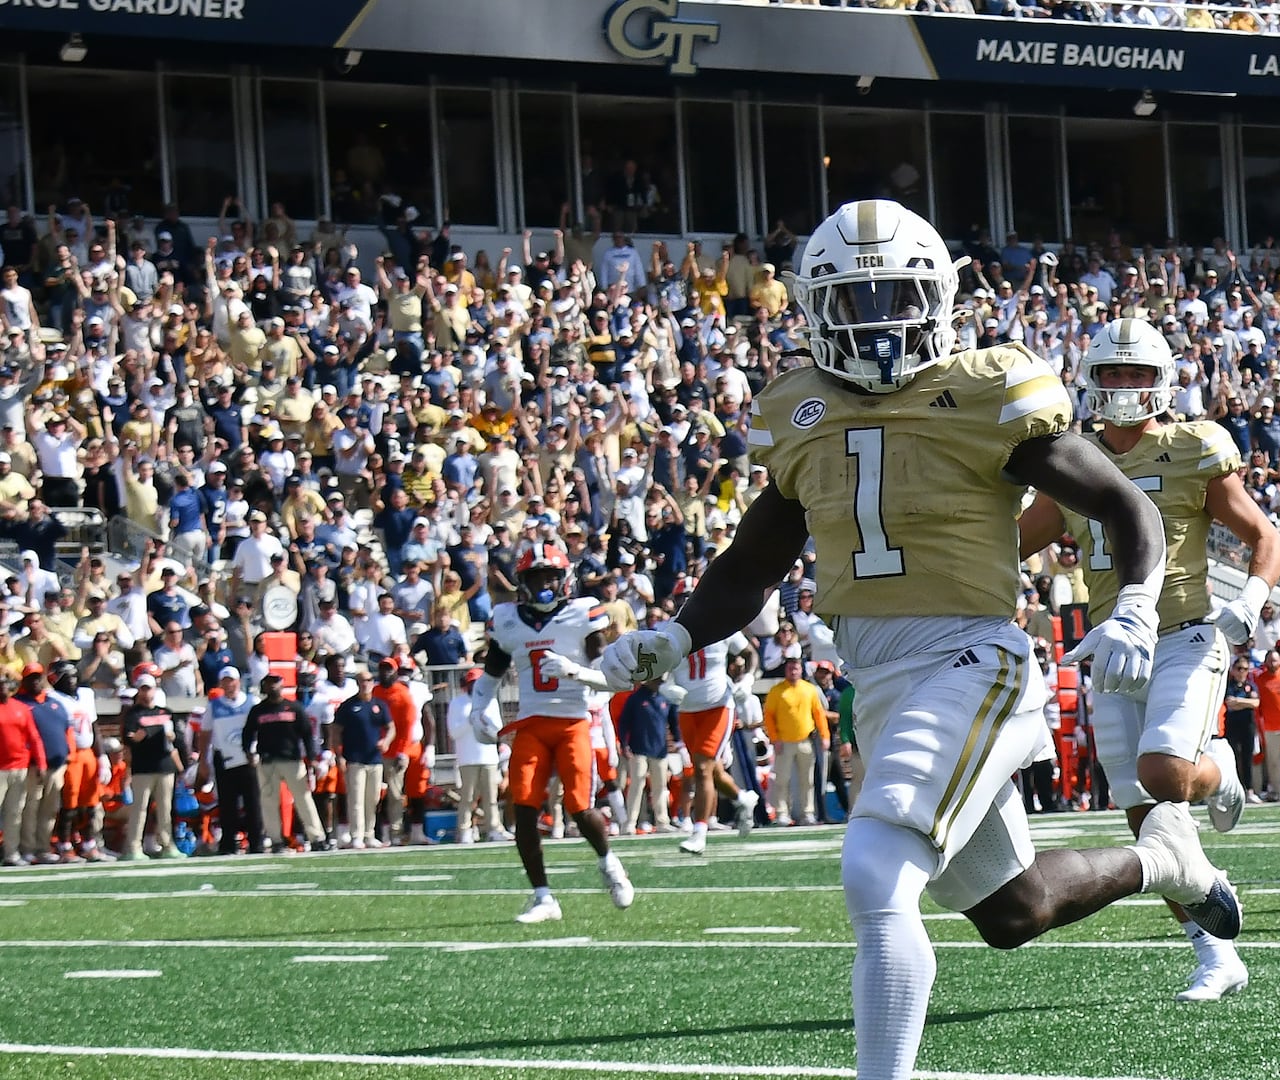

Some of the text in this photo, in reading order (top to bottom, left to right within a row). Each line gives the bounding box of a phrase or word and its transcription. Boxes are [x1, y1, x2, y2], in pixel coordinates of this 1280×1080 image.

[976, 39, 1184, 72] MAXIE BAUGHAN
[855, 255, 884, 269] TECH
[845, 426, 906, 580] 1
[1071, 608, 1085, 640] 1
[688, 649, 707, 681] 11
